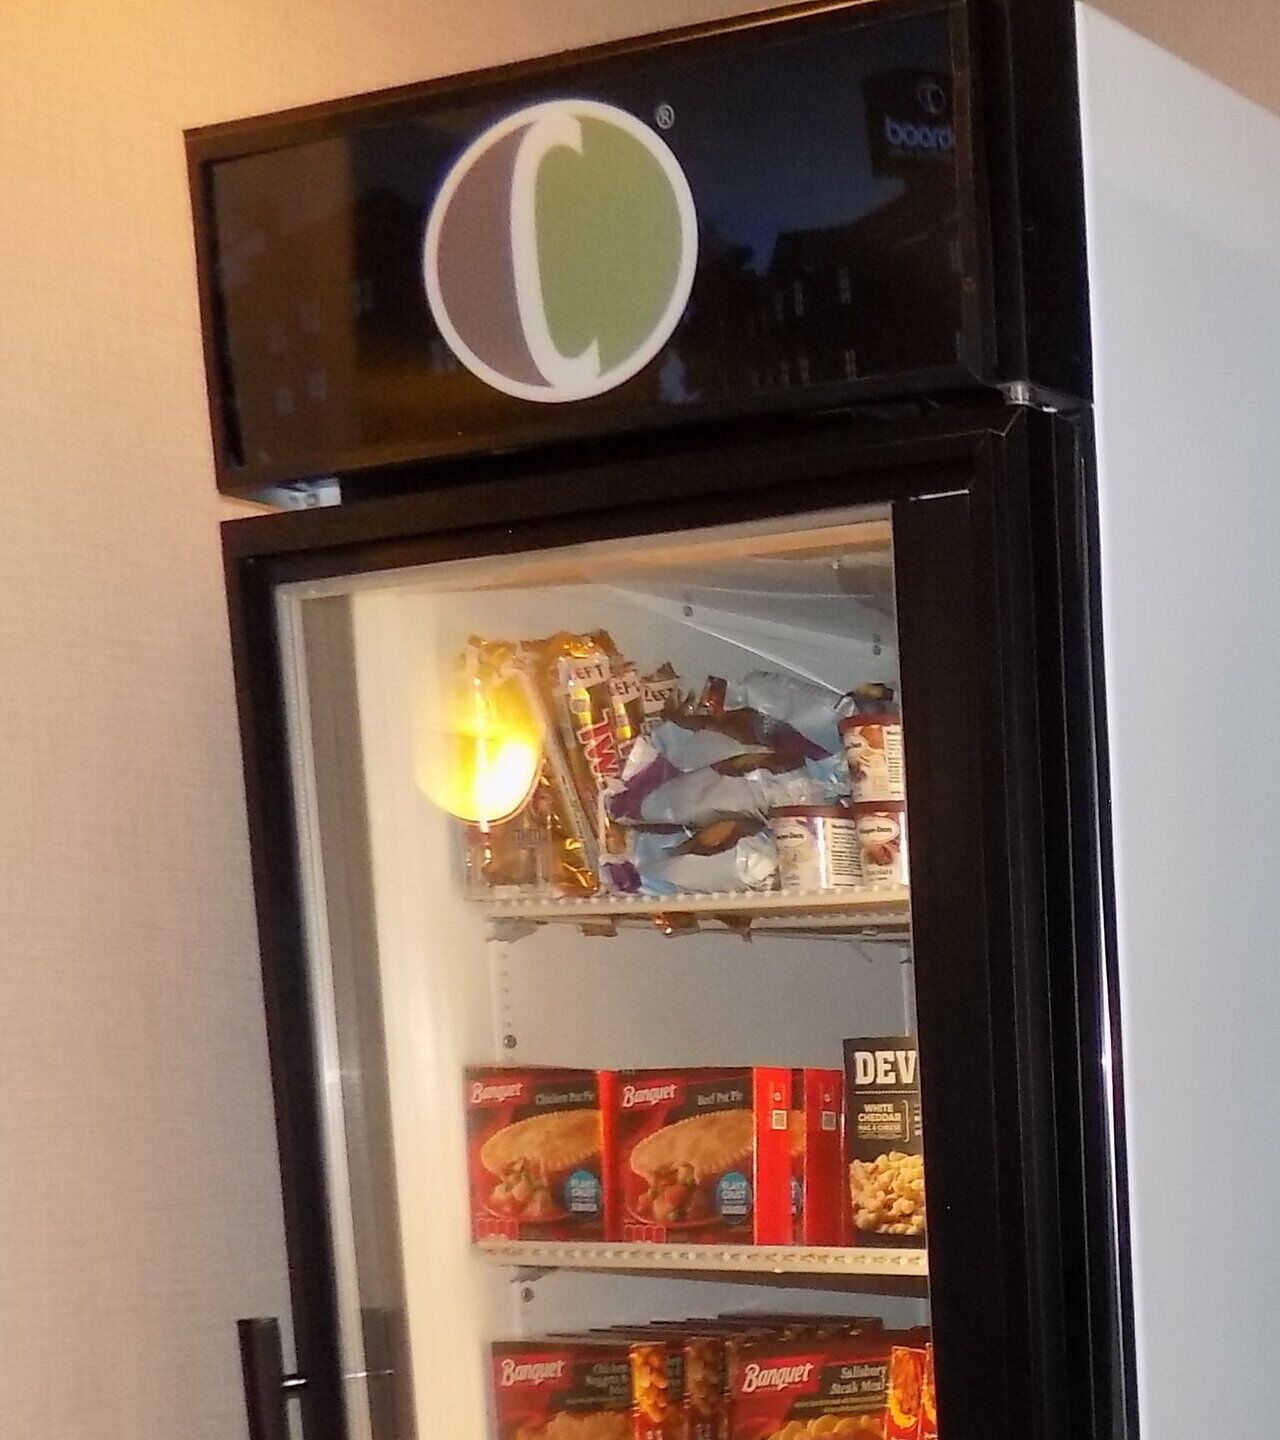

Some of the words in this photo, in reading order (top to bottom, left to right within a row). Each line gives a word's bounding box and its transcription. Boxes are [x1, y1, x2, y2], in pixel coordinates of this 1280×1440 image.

[472, 1082, 523, 1104] Banquet
[622, 1083, 677, 1108] Banquet
[858, 1113, 901, 1122] CHEDDAR
[864, 1103, 894, 1113] WHITE
[502, 1358, 566, 1387] Banquet
[742, 1362, 815, 1394] Banquet
[841, 1365, 888, 1384] Salisbury
[830, 1382, 860, 1396] Steak
